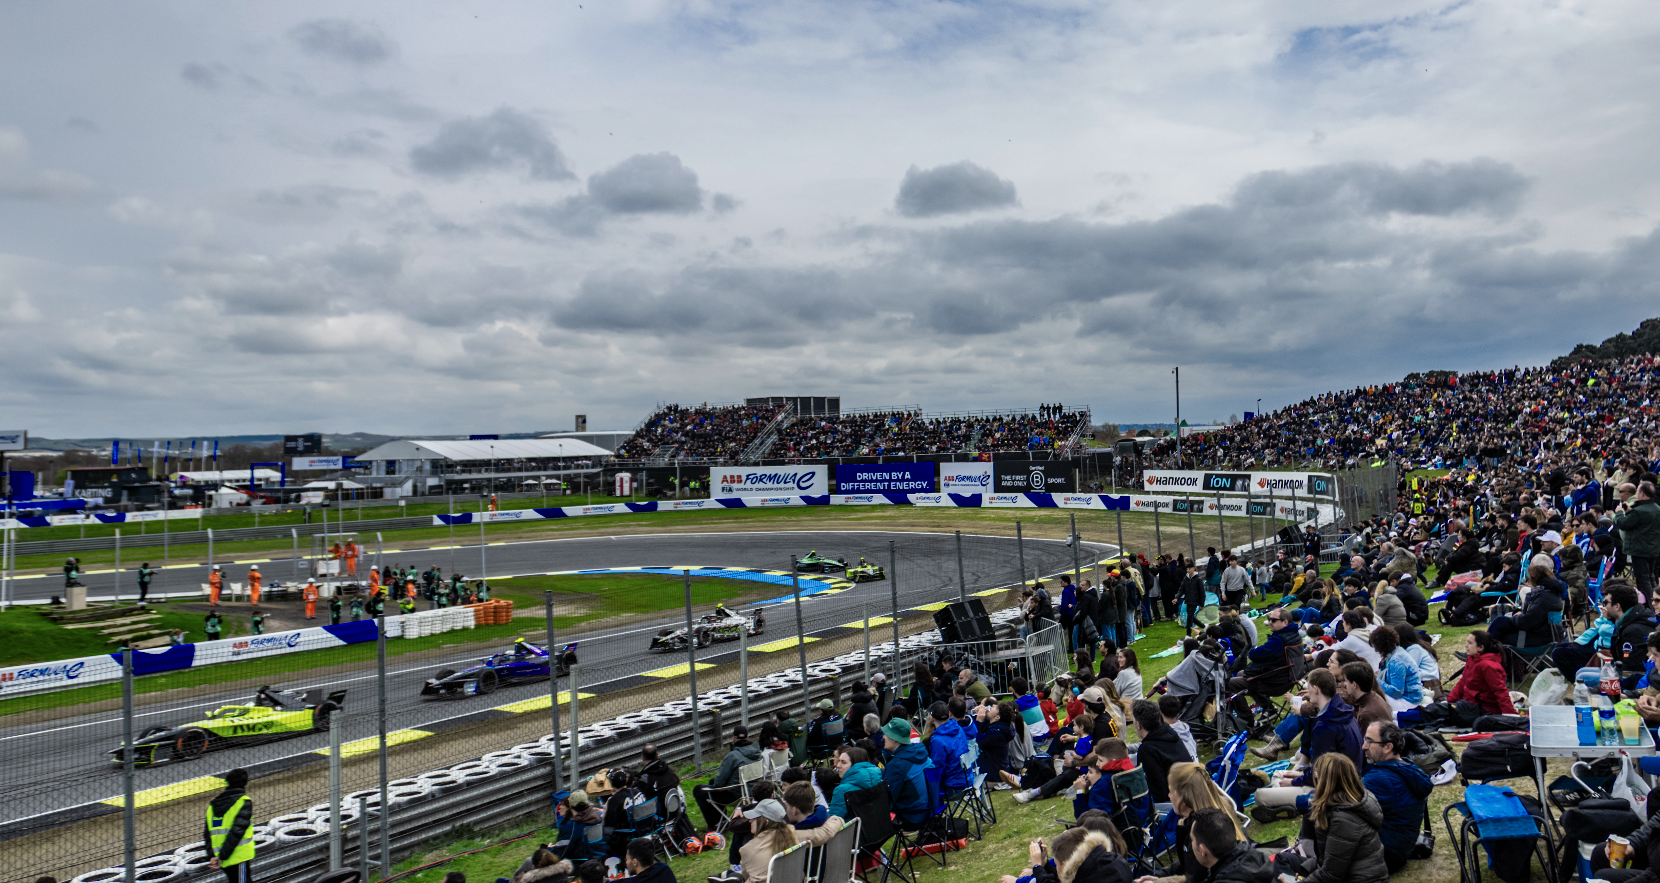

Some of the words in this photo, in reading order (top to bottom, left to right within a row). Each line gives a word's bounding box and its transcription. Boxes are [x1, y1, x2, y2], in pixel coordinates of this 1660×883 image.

[721, 474, 743, 485] ABB
[744, 472, 798, 485] FORMULA
[856, 472, 889, 481] DRIVEN
[891, 471, 903, 480] BY
[904, 471, 912, 480] A
[954, 474, 982, 483] FORMULA
[840, 482, 889, 490] DIFFERENT
[890, 481, 929, 490] ENERGY.
[74, 488, 113, 498] KARTING
[232, 640, 249, 650] ABB
[248, 633, 289, 650] FORMULA
[15, 664, 67, 681] FORMULA
